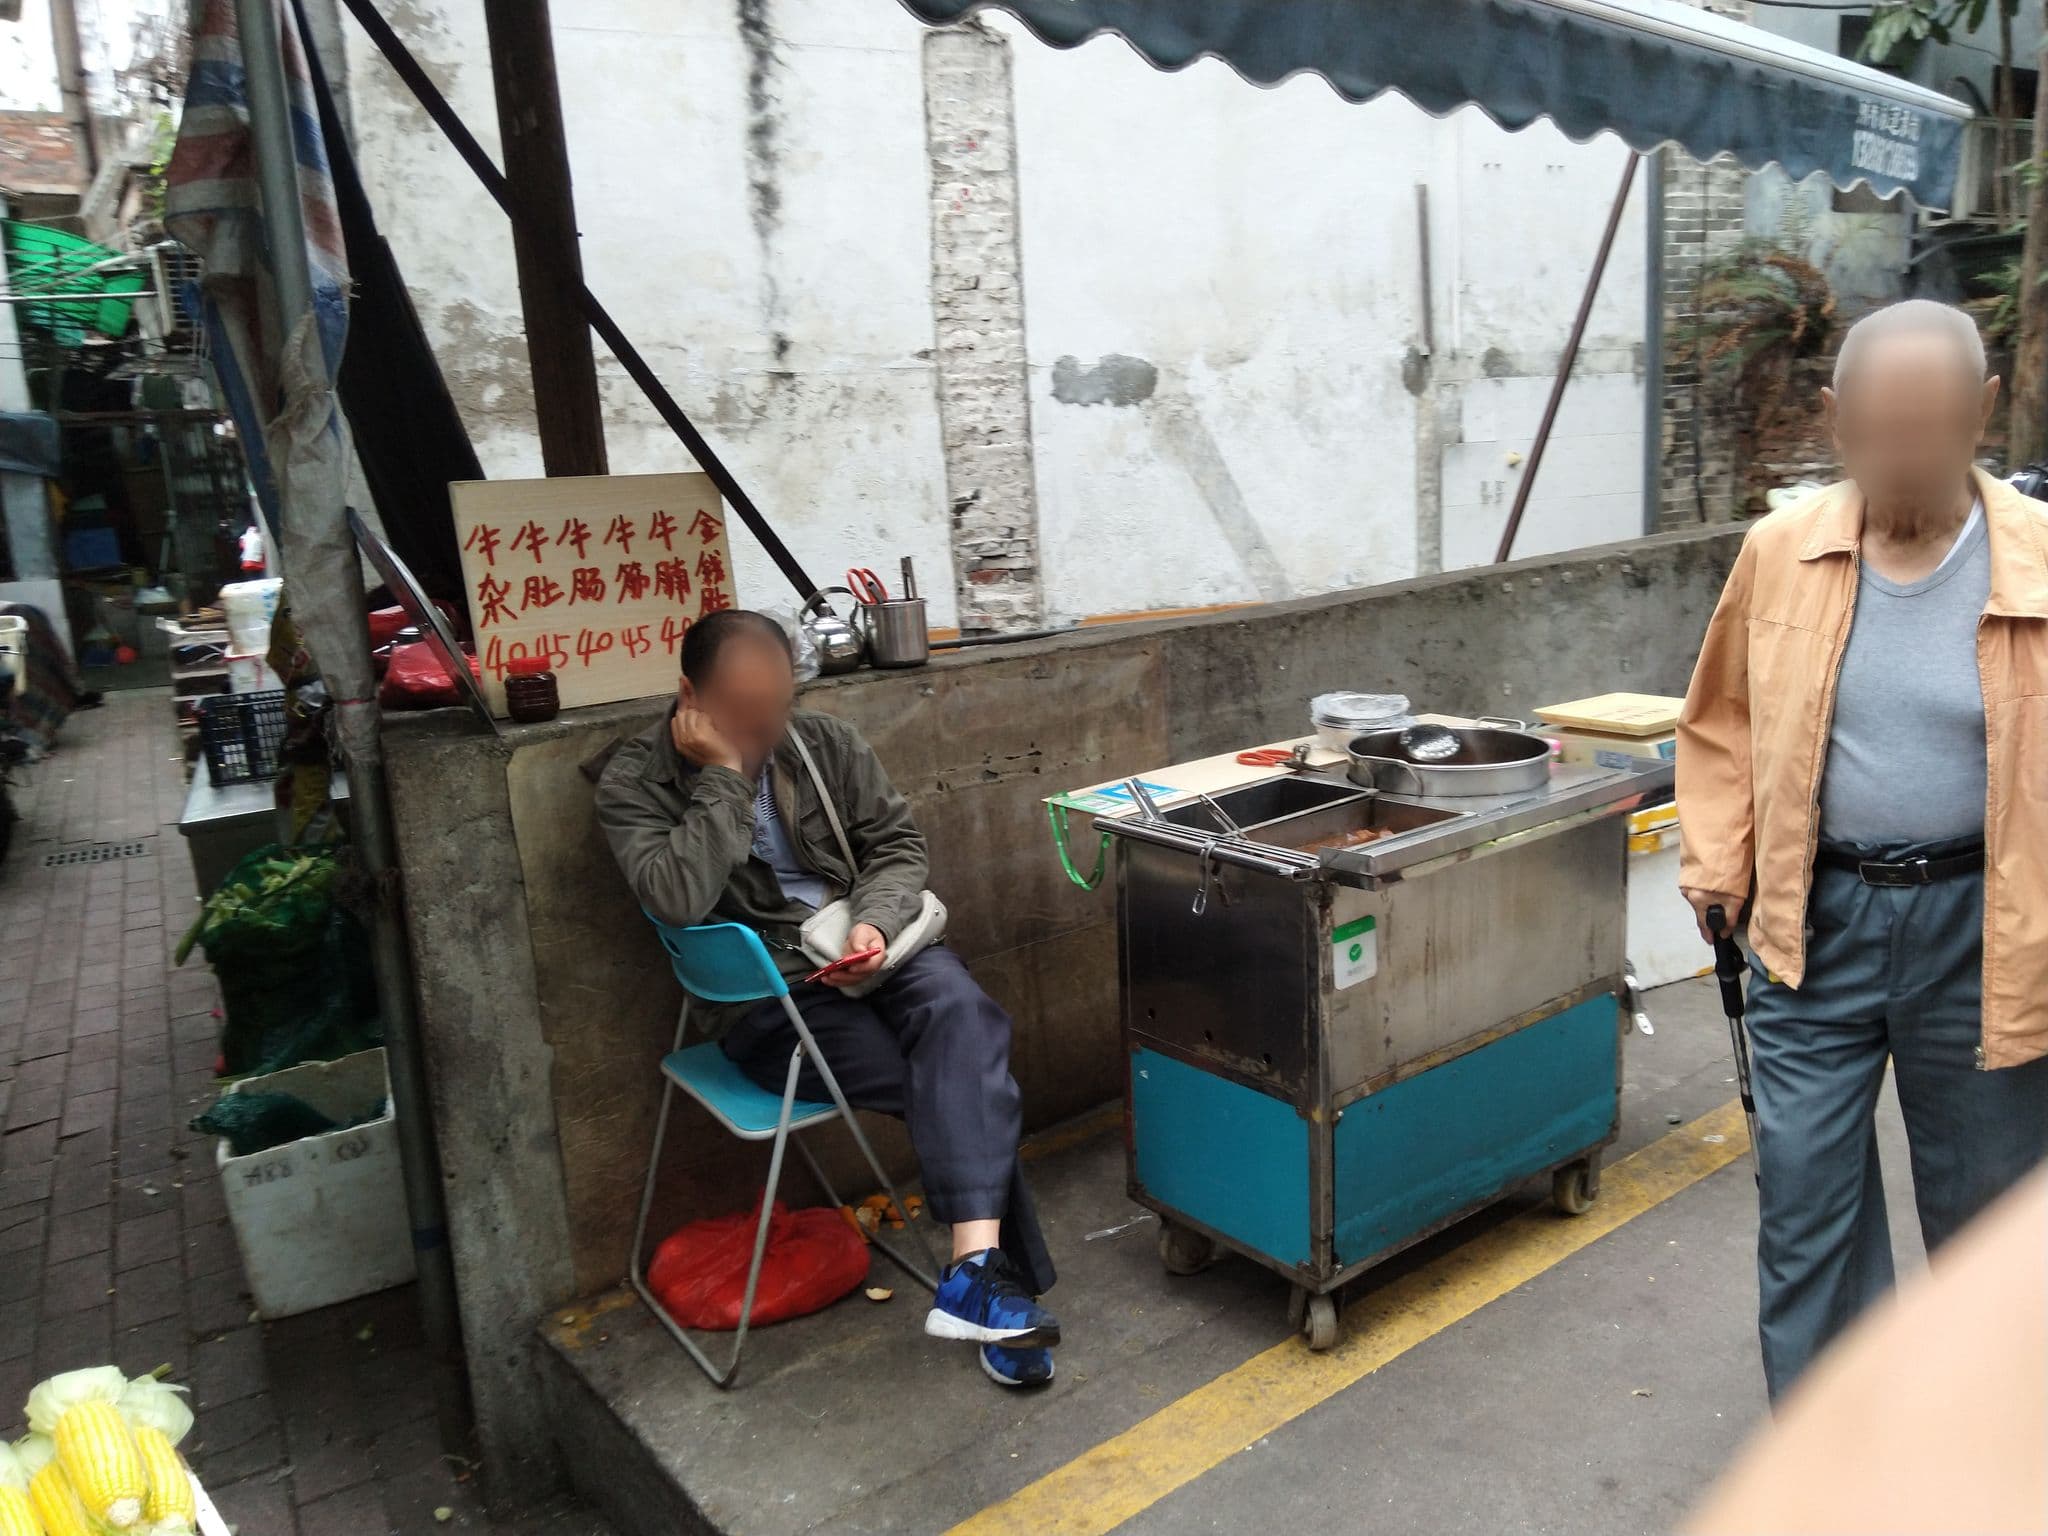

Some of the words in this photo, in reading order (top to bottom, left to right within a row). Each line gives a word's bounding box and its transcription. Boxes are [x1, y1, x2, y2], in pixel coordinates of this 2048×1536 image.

[510, 519, 565, 611] 牛肚
[576, 627, 613, 667] 40
[621, 624, 652, 659] 45
